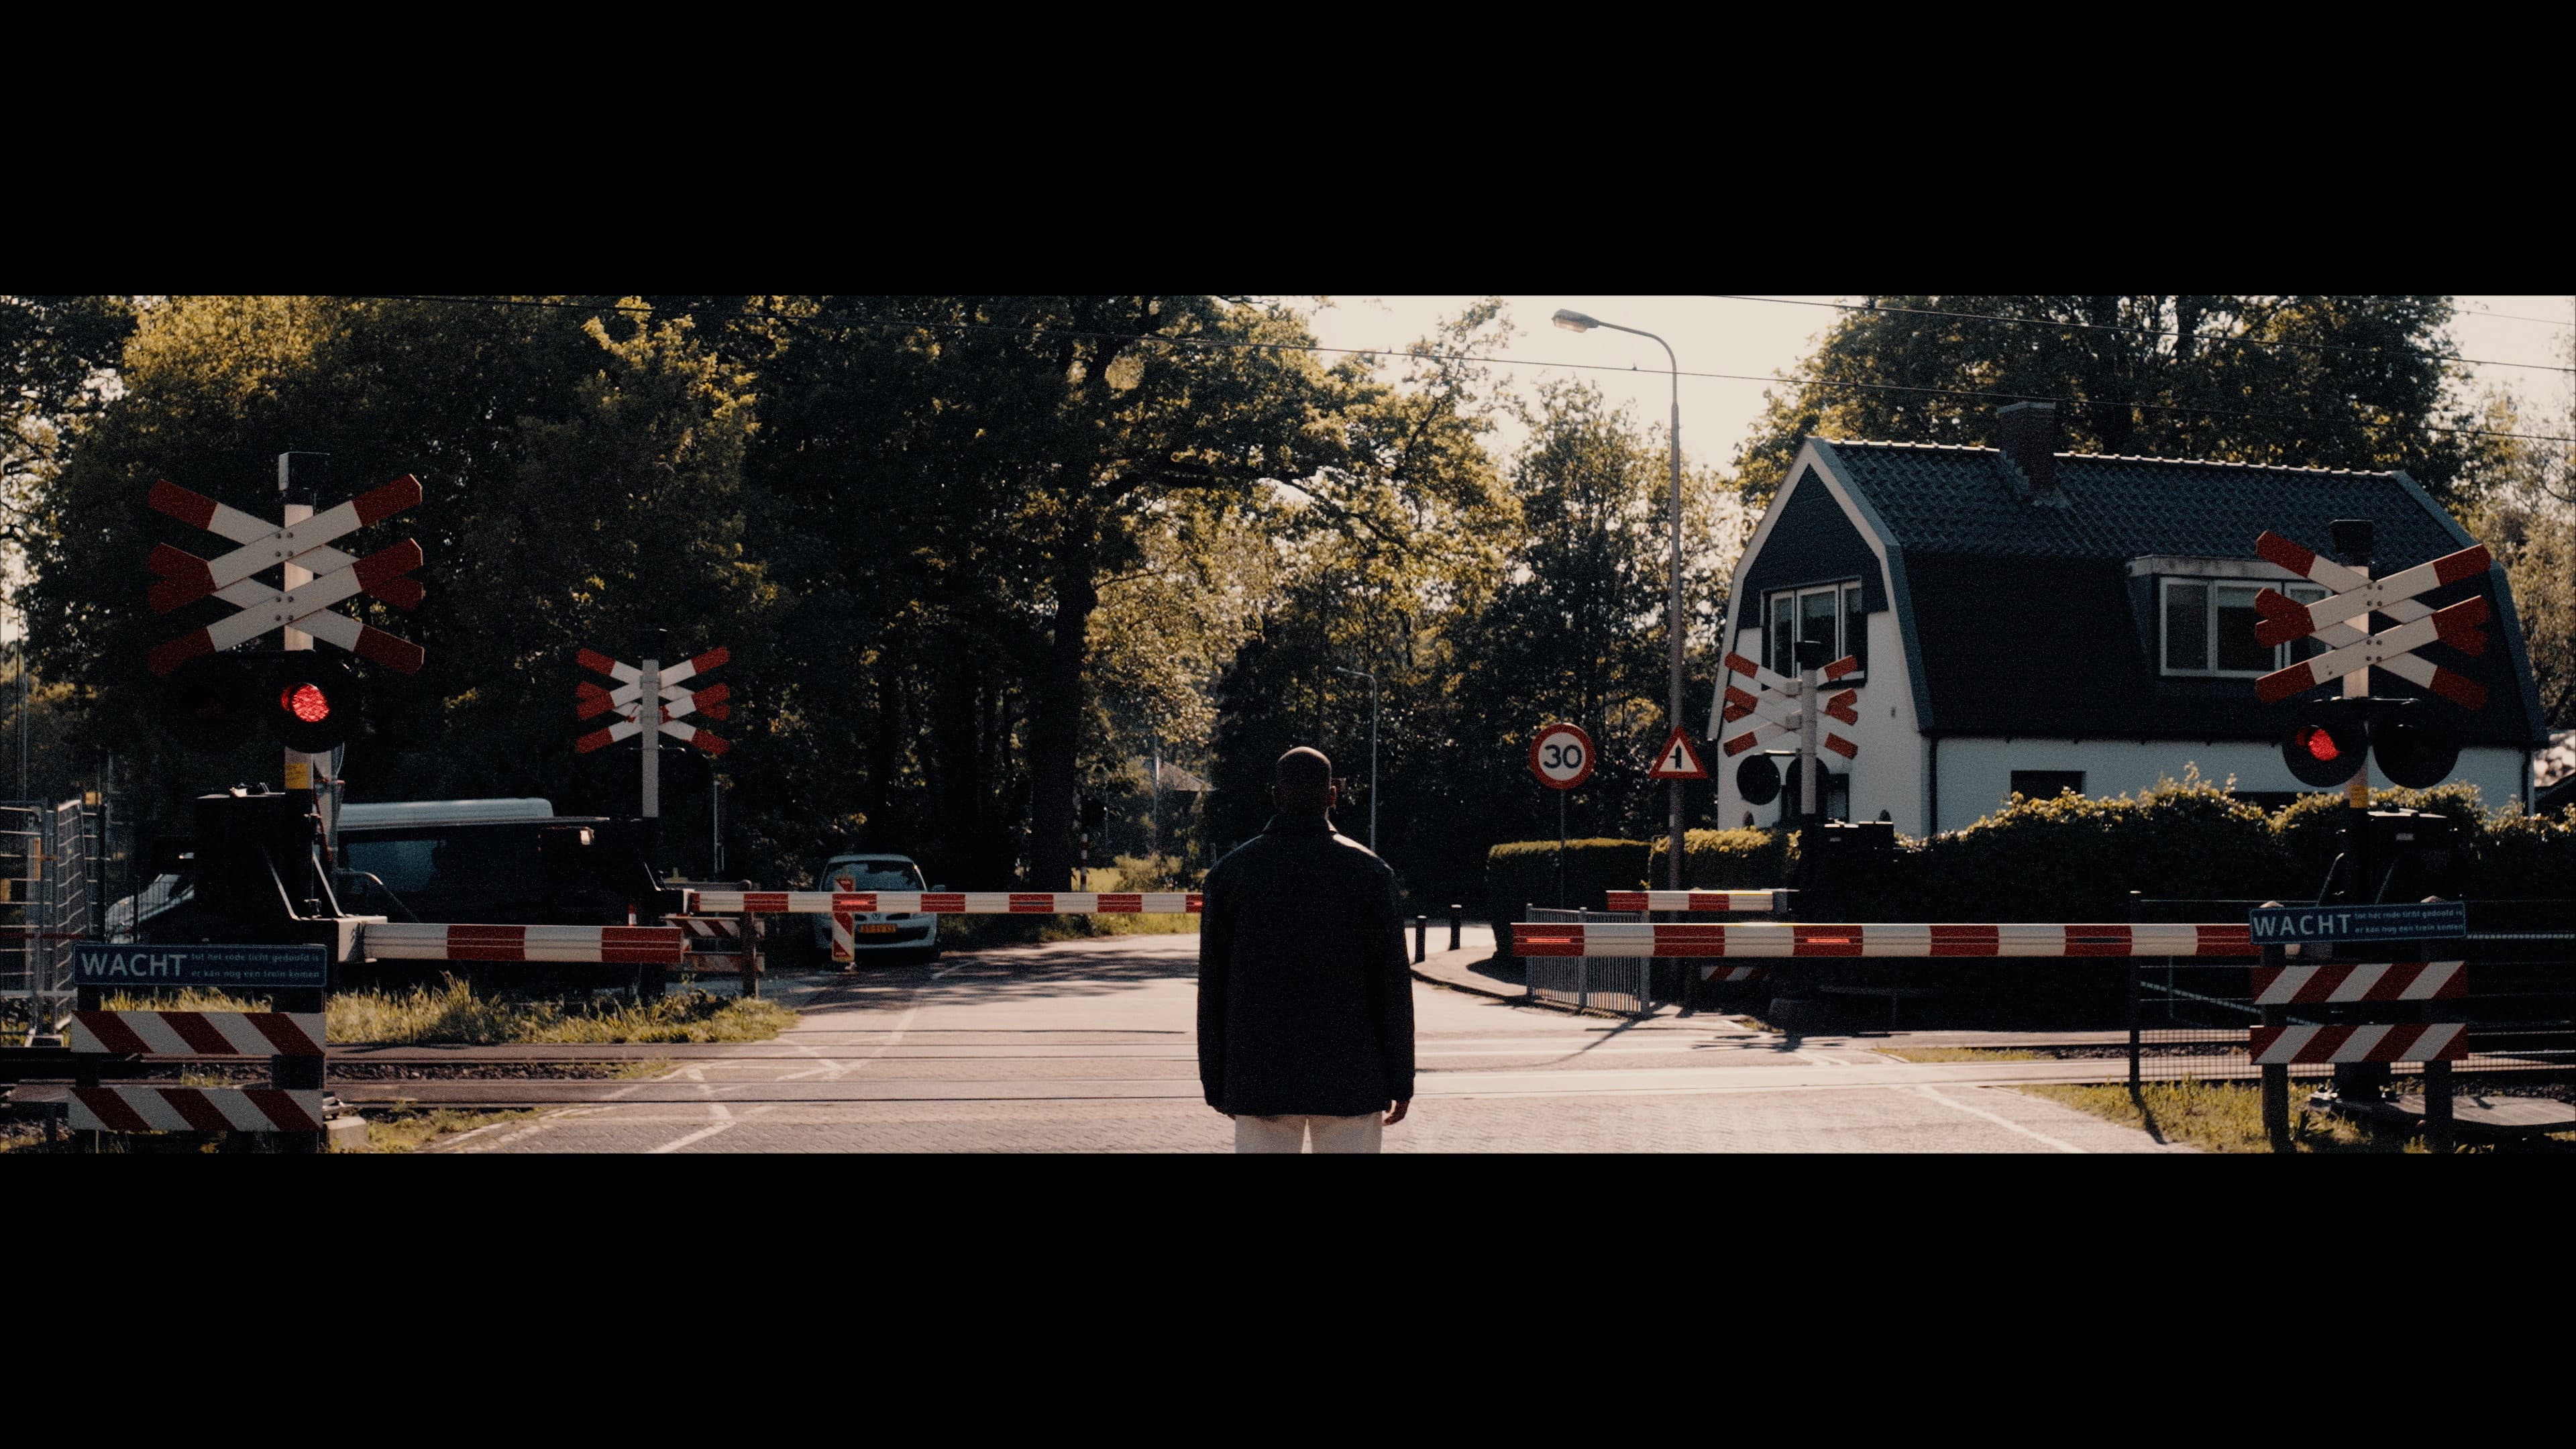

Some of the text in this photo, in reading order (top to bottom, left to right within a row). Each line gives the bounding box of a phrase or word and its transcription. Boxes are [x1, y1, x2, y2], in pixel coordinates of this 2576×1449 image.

[1544, 745, 1582, 769] 30
[2253, 914, 2351, 936] WACHT
[2422, 909, 2454, 919] gedoofd
[81, 953, 188, 977] WACHT
